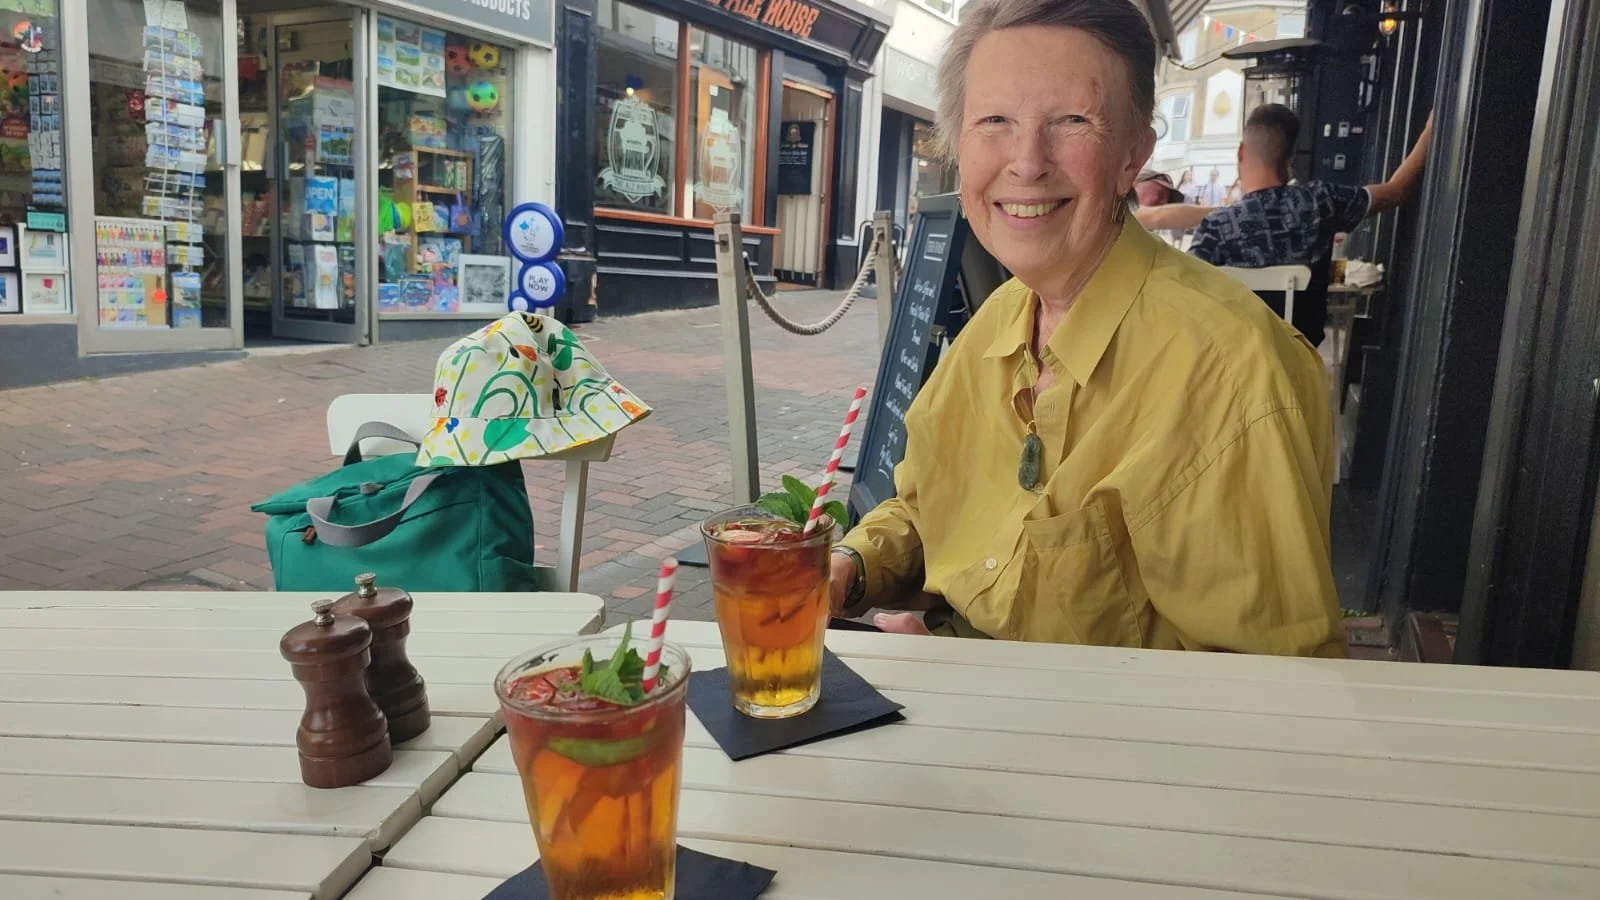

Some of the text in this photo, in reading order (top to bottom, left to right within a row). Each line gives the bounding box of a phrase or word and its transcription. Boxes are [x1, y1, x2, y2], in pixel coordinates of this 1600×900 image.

[463, 0, 530, 20] DUCTS
[762, 0, 819, 38] HOUSE
[529, 275, 549, 284] PLAY
[529, 283, 549, 292] NOW
